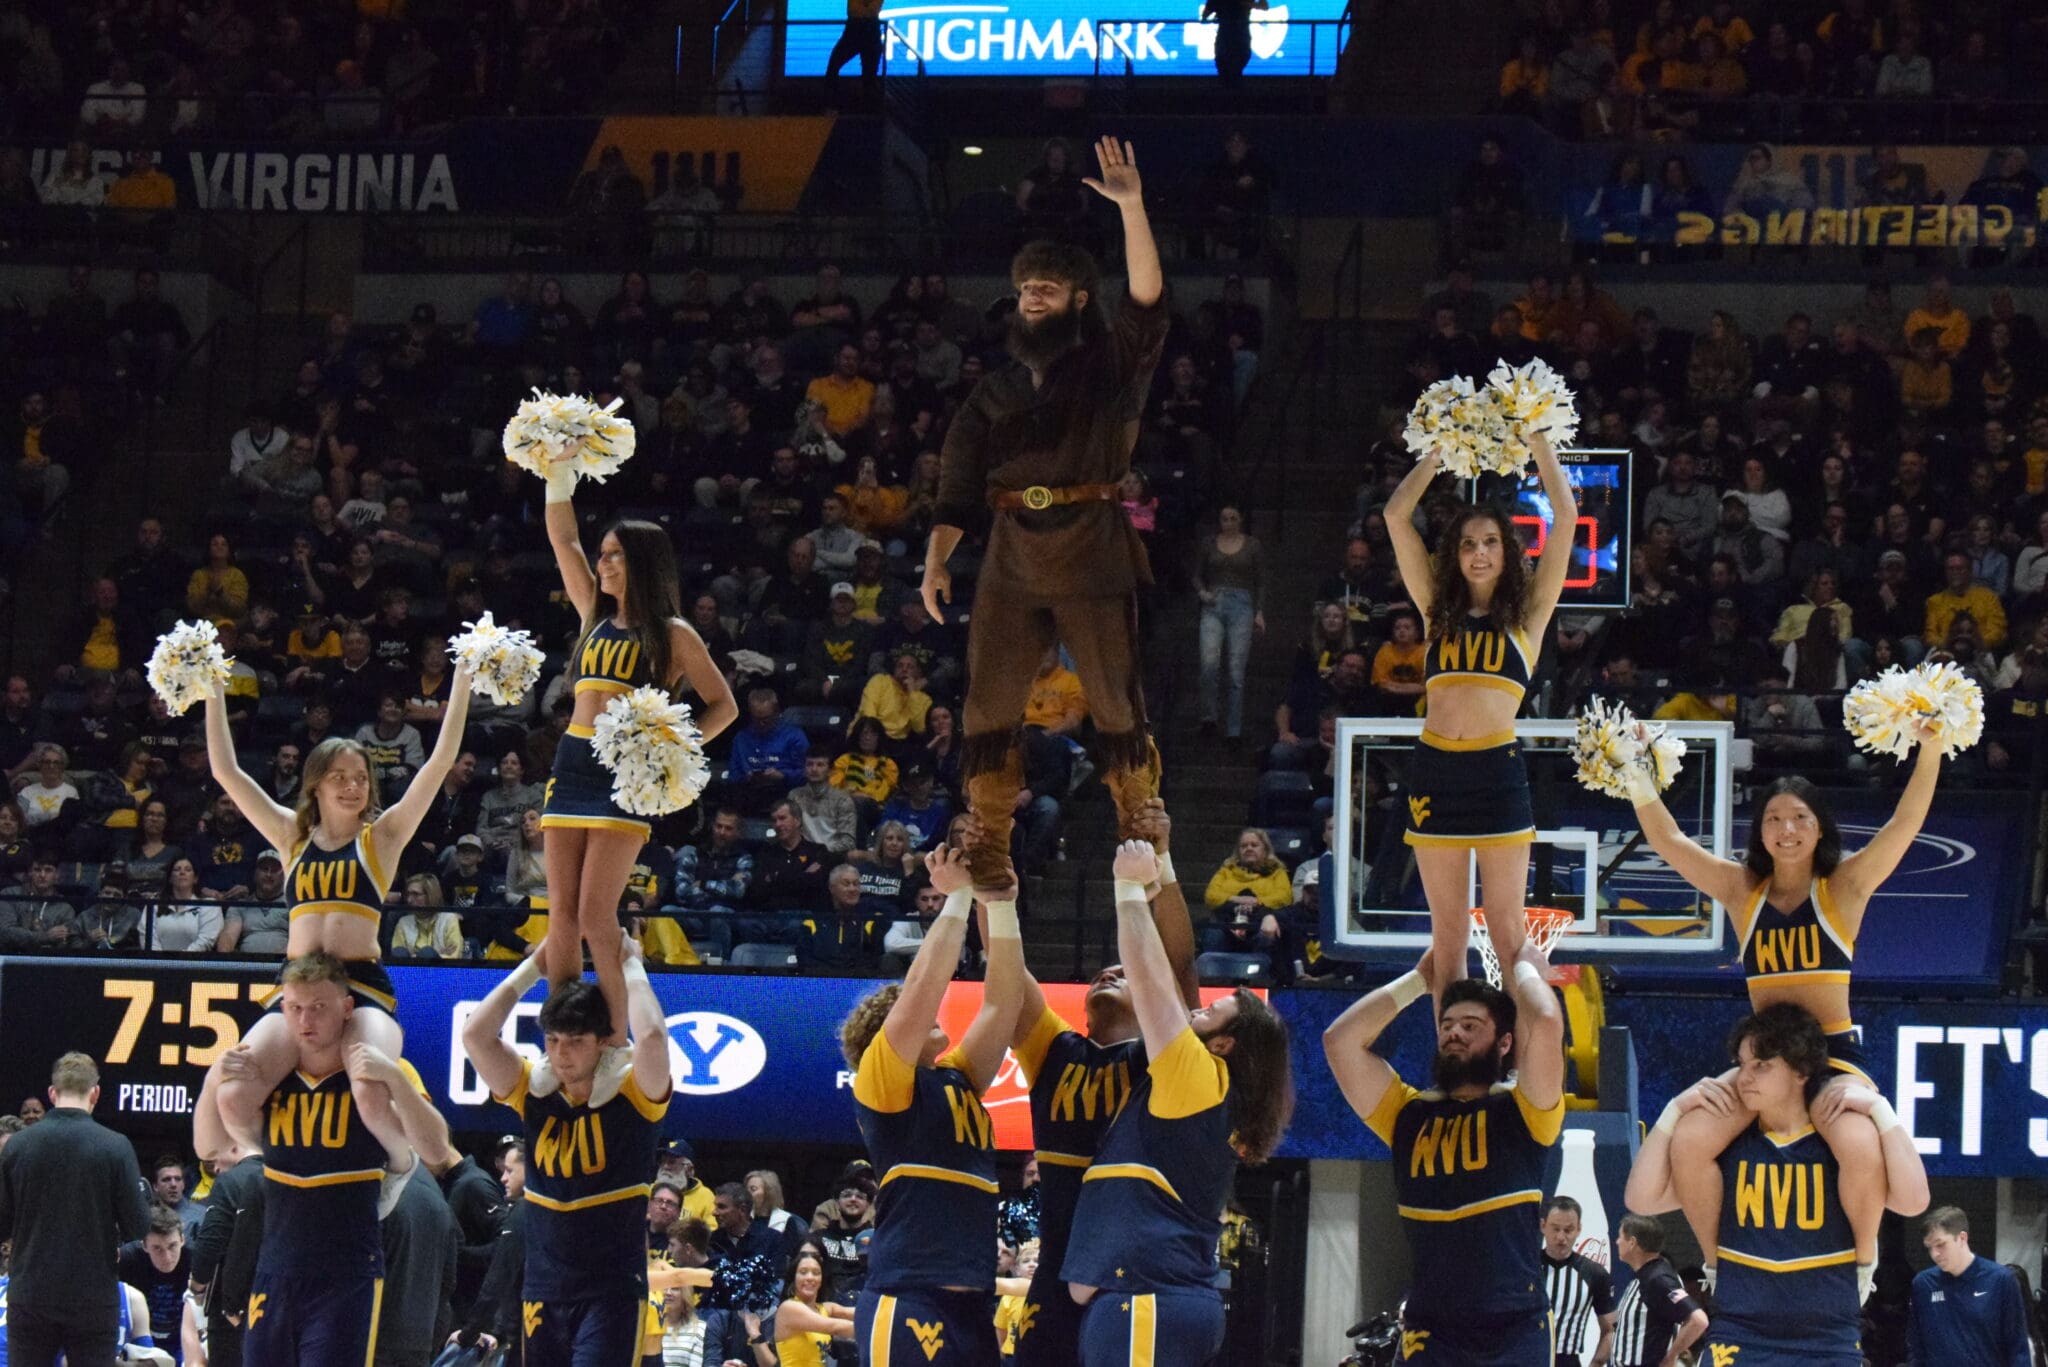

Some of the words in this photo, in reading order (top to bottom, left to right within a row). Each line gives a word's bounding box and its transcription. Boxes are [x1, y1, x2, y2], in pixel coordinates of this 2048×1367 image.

[30, 148, 163, 206] WS
[188, 151, 460, 212] VIRGINIA
[581, 637, 642, 680] WVU
[1438, 632, 1505, 673] WVU
[294, 859, 358, 902] WVU
[1754, 923, 1822, 974] WVU
[118, 1083, 194, 1113] PERIOD:
[268, 1091, 351, 1149] WVU
[944, 1084, 996, 1151] WV
[1050, 1060, 1132, 1122] WVU
[1852, 1024, 2048, 1158] ET'
[534, 1112, 606, 1180] WVU
[1410, 1108, 1489, 1179] WVU
[1735, 1160, 1825, 1230] WVU
